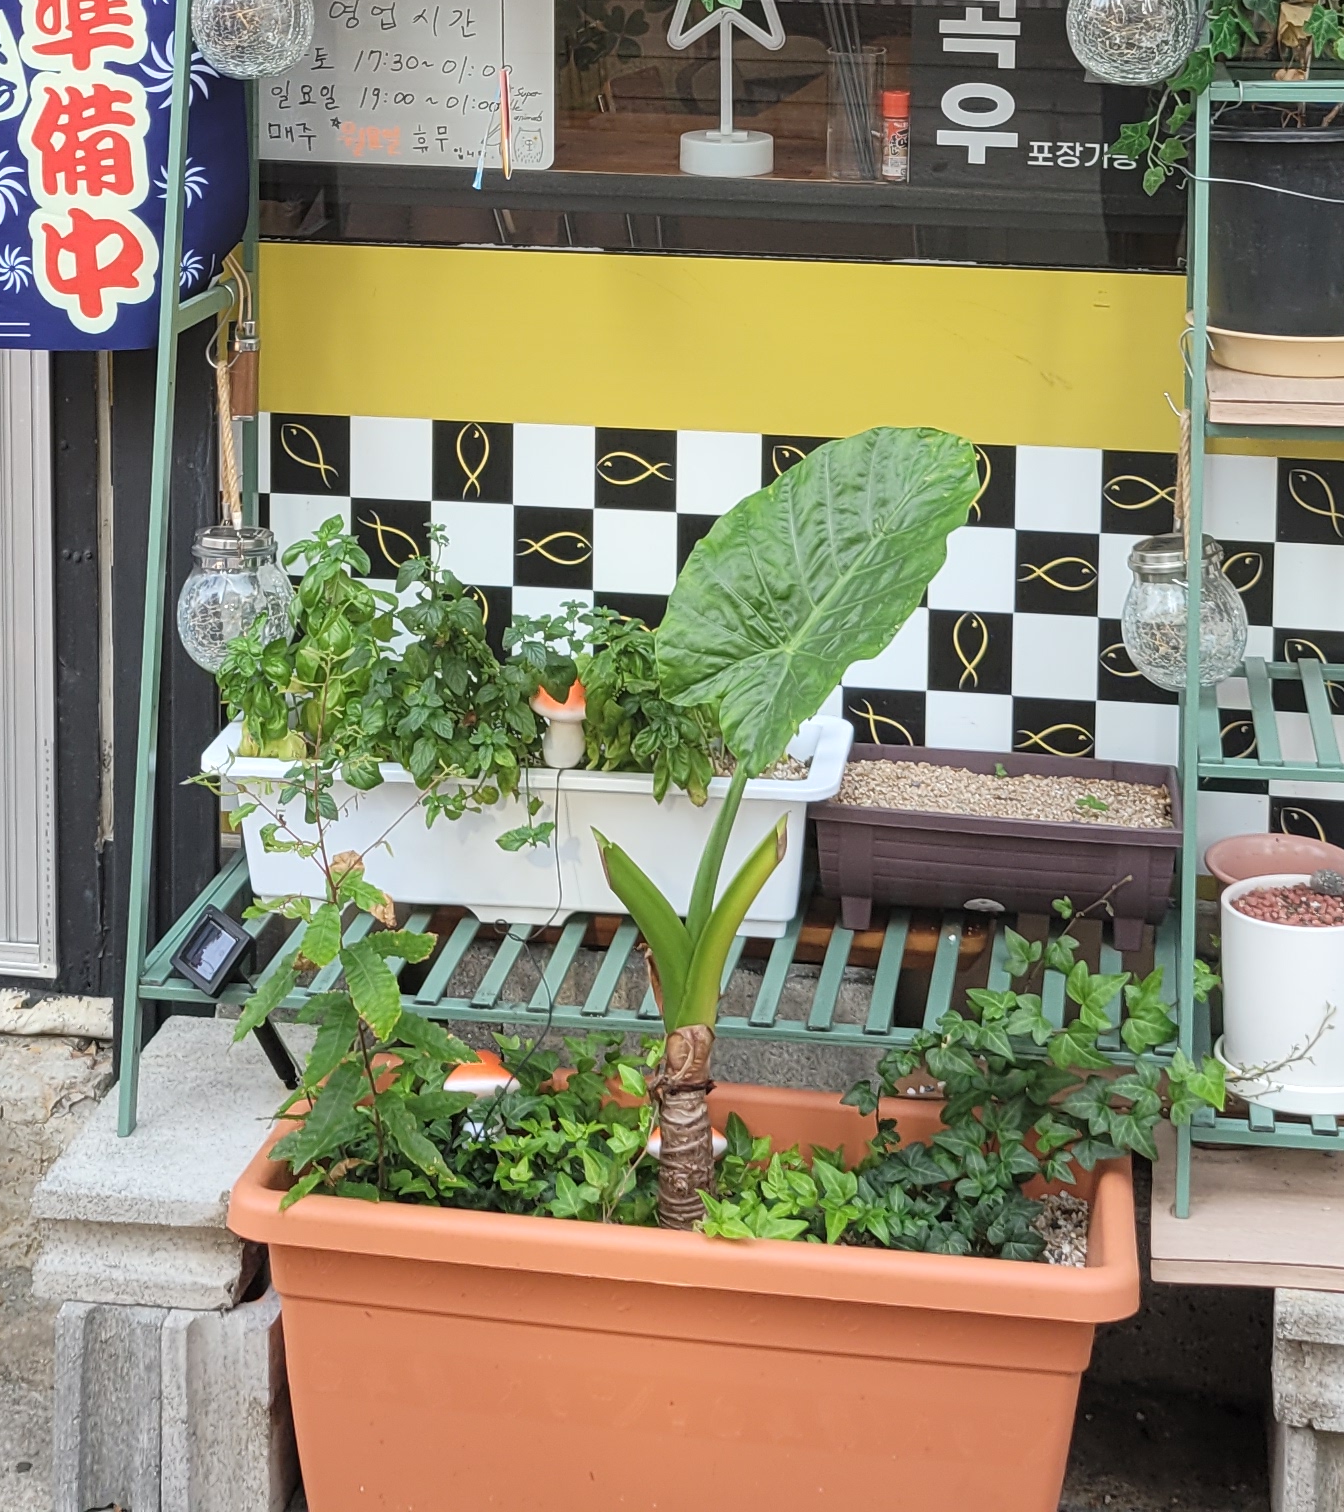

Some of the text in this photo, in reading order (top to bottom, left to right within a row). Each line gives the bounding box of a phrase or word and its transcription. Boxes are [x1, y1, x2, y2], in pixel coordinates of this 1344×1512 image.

[328, 0, 476, 38] 영업시간
[271, 80, 340, 110] 일요일
[268, 122, 317, 152] 매주
[339, 120, 402, 158] 월요일
[412, 124, 449, 154] 휴무
